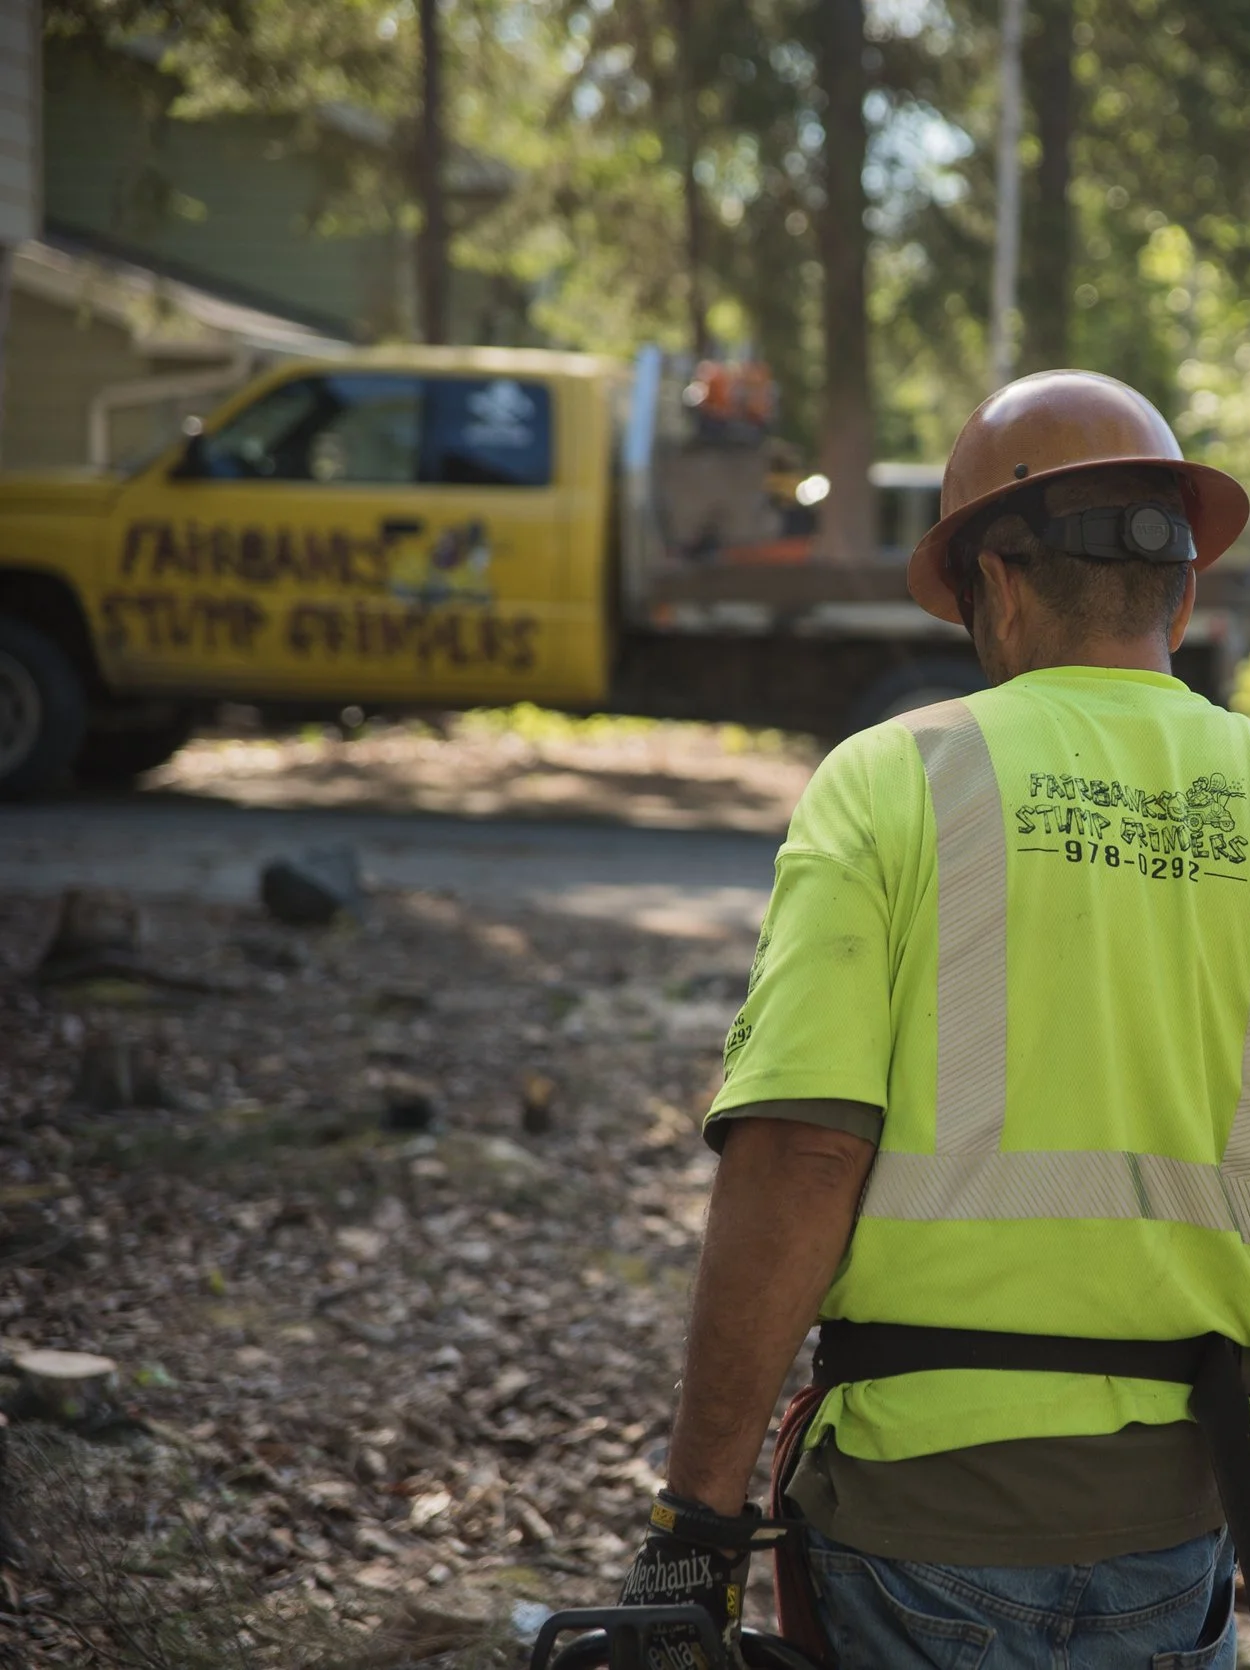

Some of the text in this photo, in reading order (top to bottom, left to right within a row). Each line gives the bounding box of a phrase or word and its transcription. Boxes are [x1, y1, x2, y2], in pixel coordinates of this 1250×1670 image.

[1016, 804, 1112, 840] STUMP
[1064, 840, 1201, 882] 978-0292
[625, 1549, 713, 1597] Mechanix
